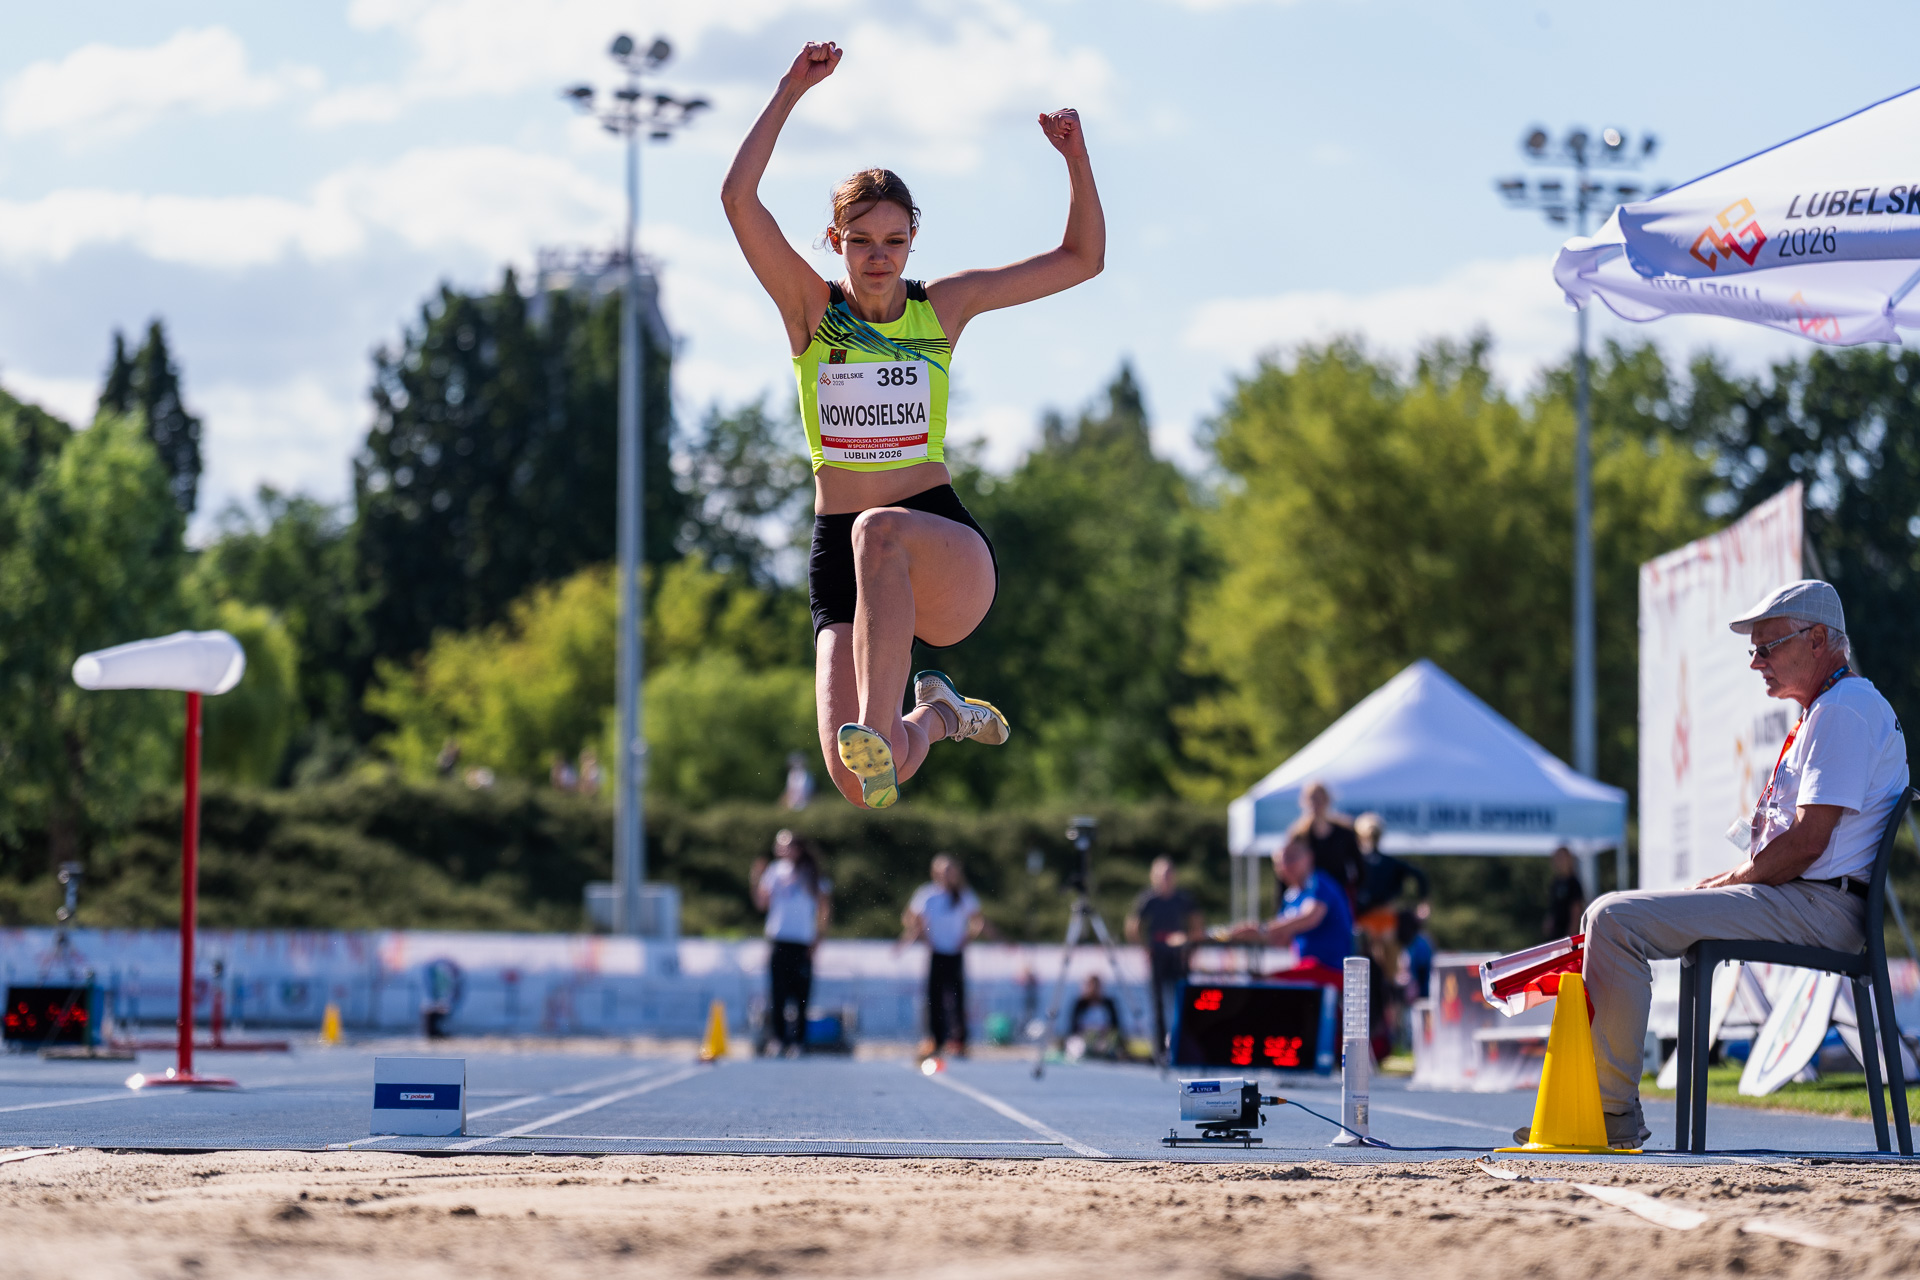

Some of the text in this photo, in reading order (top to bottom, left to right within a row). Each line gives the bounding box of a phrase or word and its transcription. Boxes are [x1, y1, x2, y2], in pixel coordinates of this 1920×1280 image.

[1777, 225, 1837, 257] 2026
[877, 367, 918, 386] 385
[820, 402, 926, 427] NOWOSIELSKA
[844, 450, 902, 459] LUBLIN 2026
